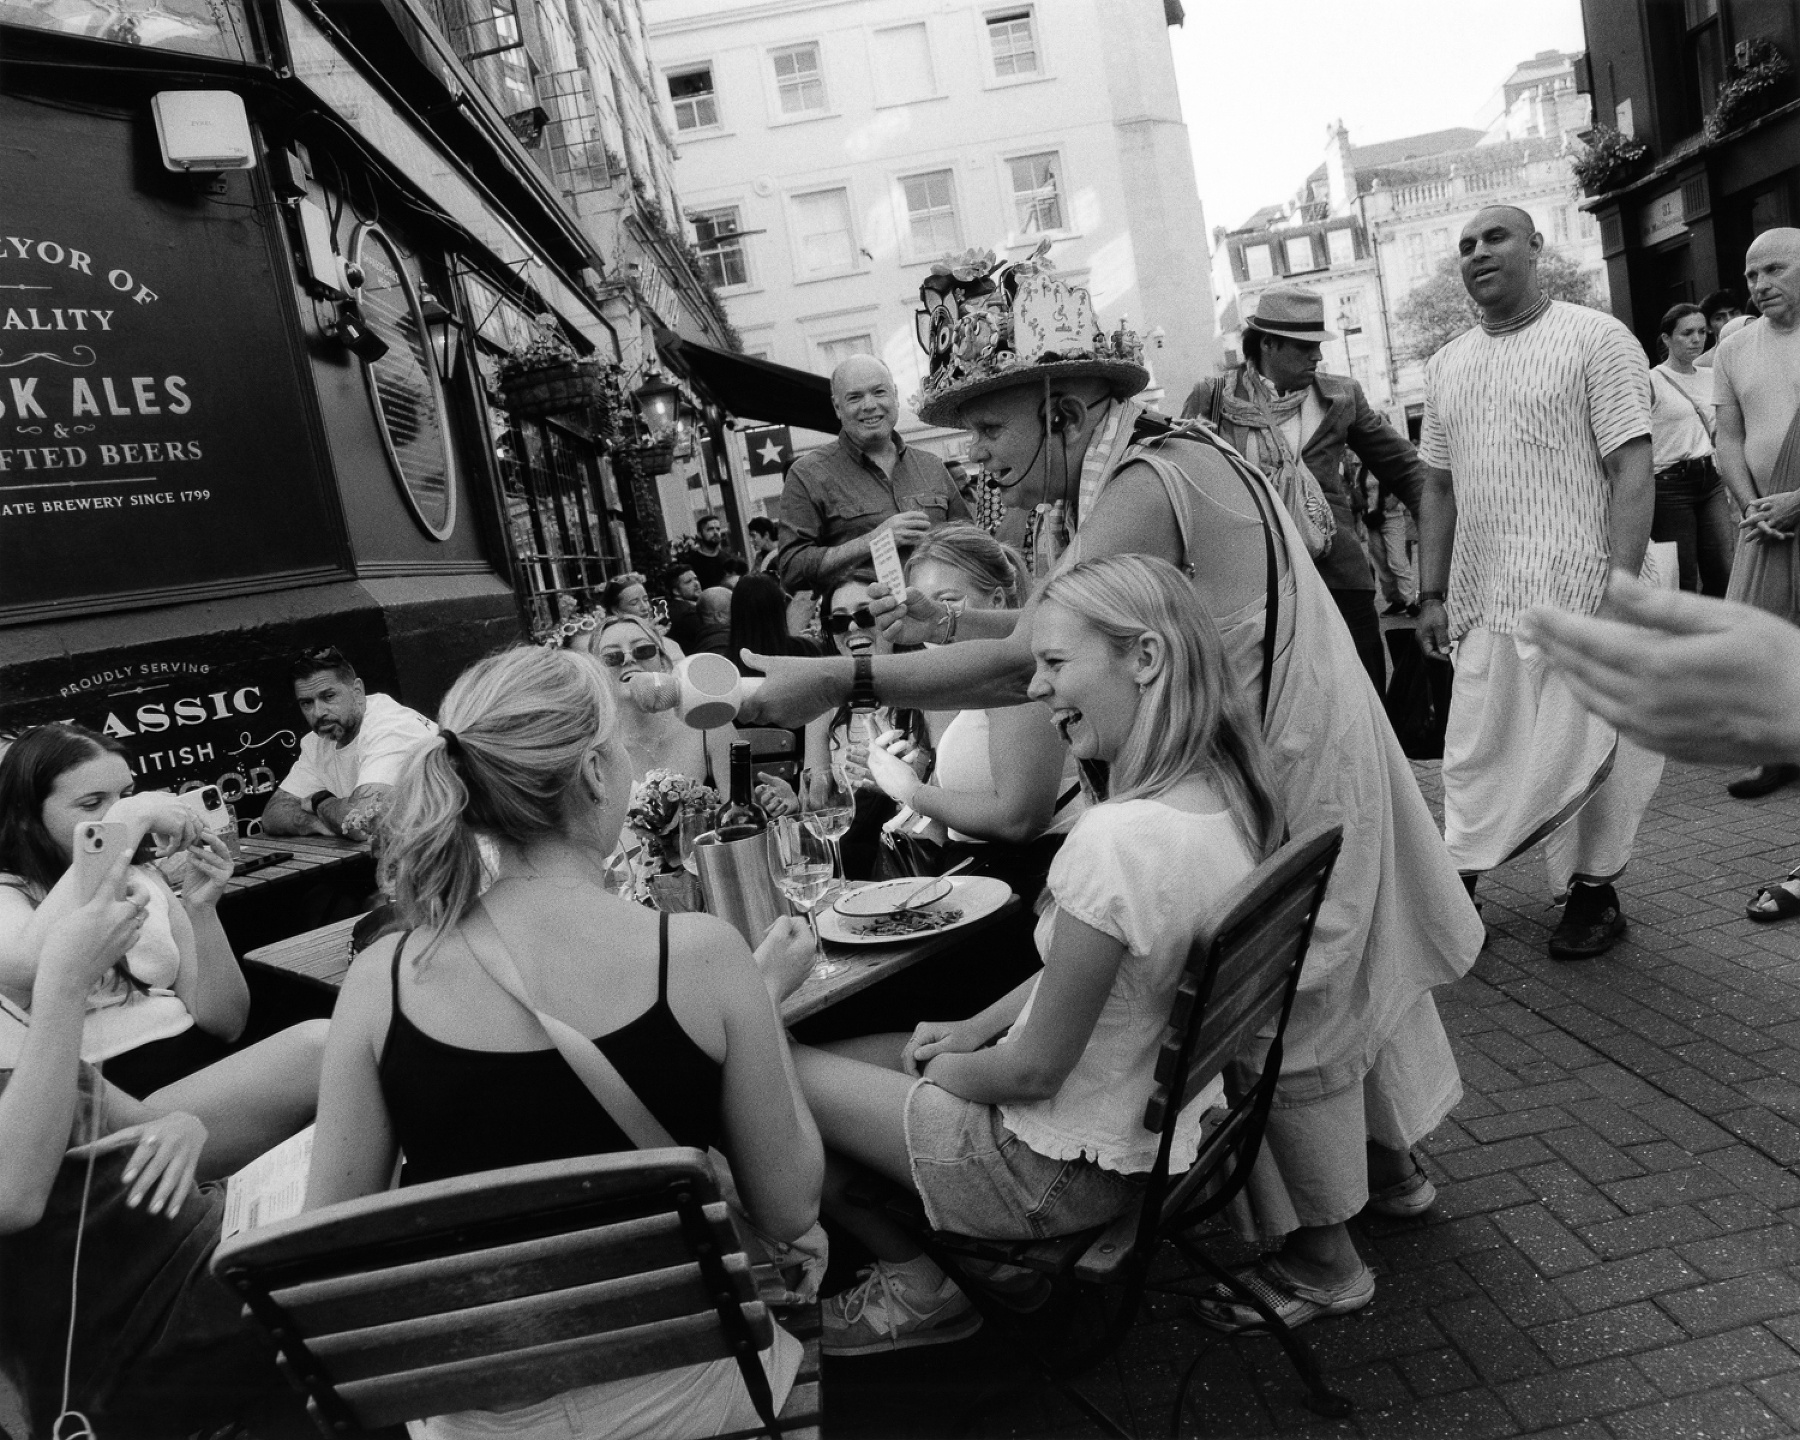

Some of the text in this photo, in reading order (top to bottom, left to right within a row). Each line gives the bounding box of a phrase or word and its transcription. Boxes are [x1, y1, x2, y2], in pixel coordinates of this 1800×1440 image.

[0, 235, 159, 305] YOR OF
[2, 307, 115, 331] ALITY
[0, 375, 192, 419] K ALES
[53, 422, 71, 438] &
[98, 440, 203, 466] BEERS
[2, 489, 211, 516] ATE BREWERY SINCE 1799
[60, 662, 211, 698] PROUDLY SERVING
[27, 686, 264, 741] ASSIC
[131, 742, 216, 776] ITISH
